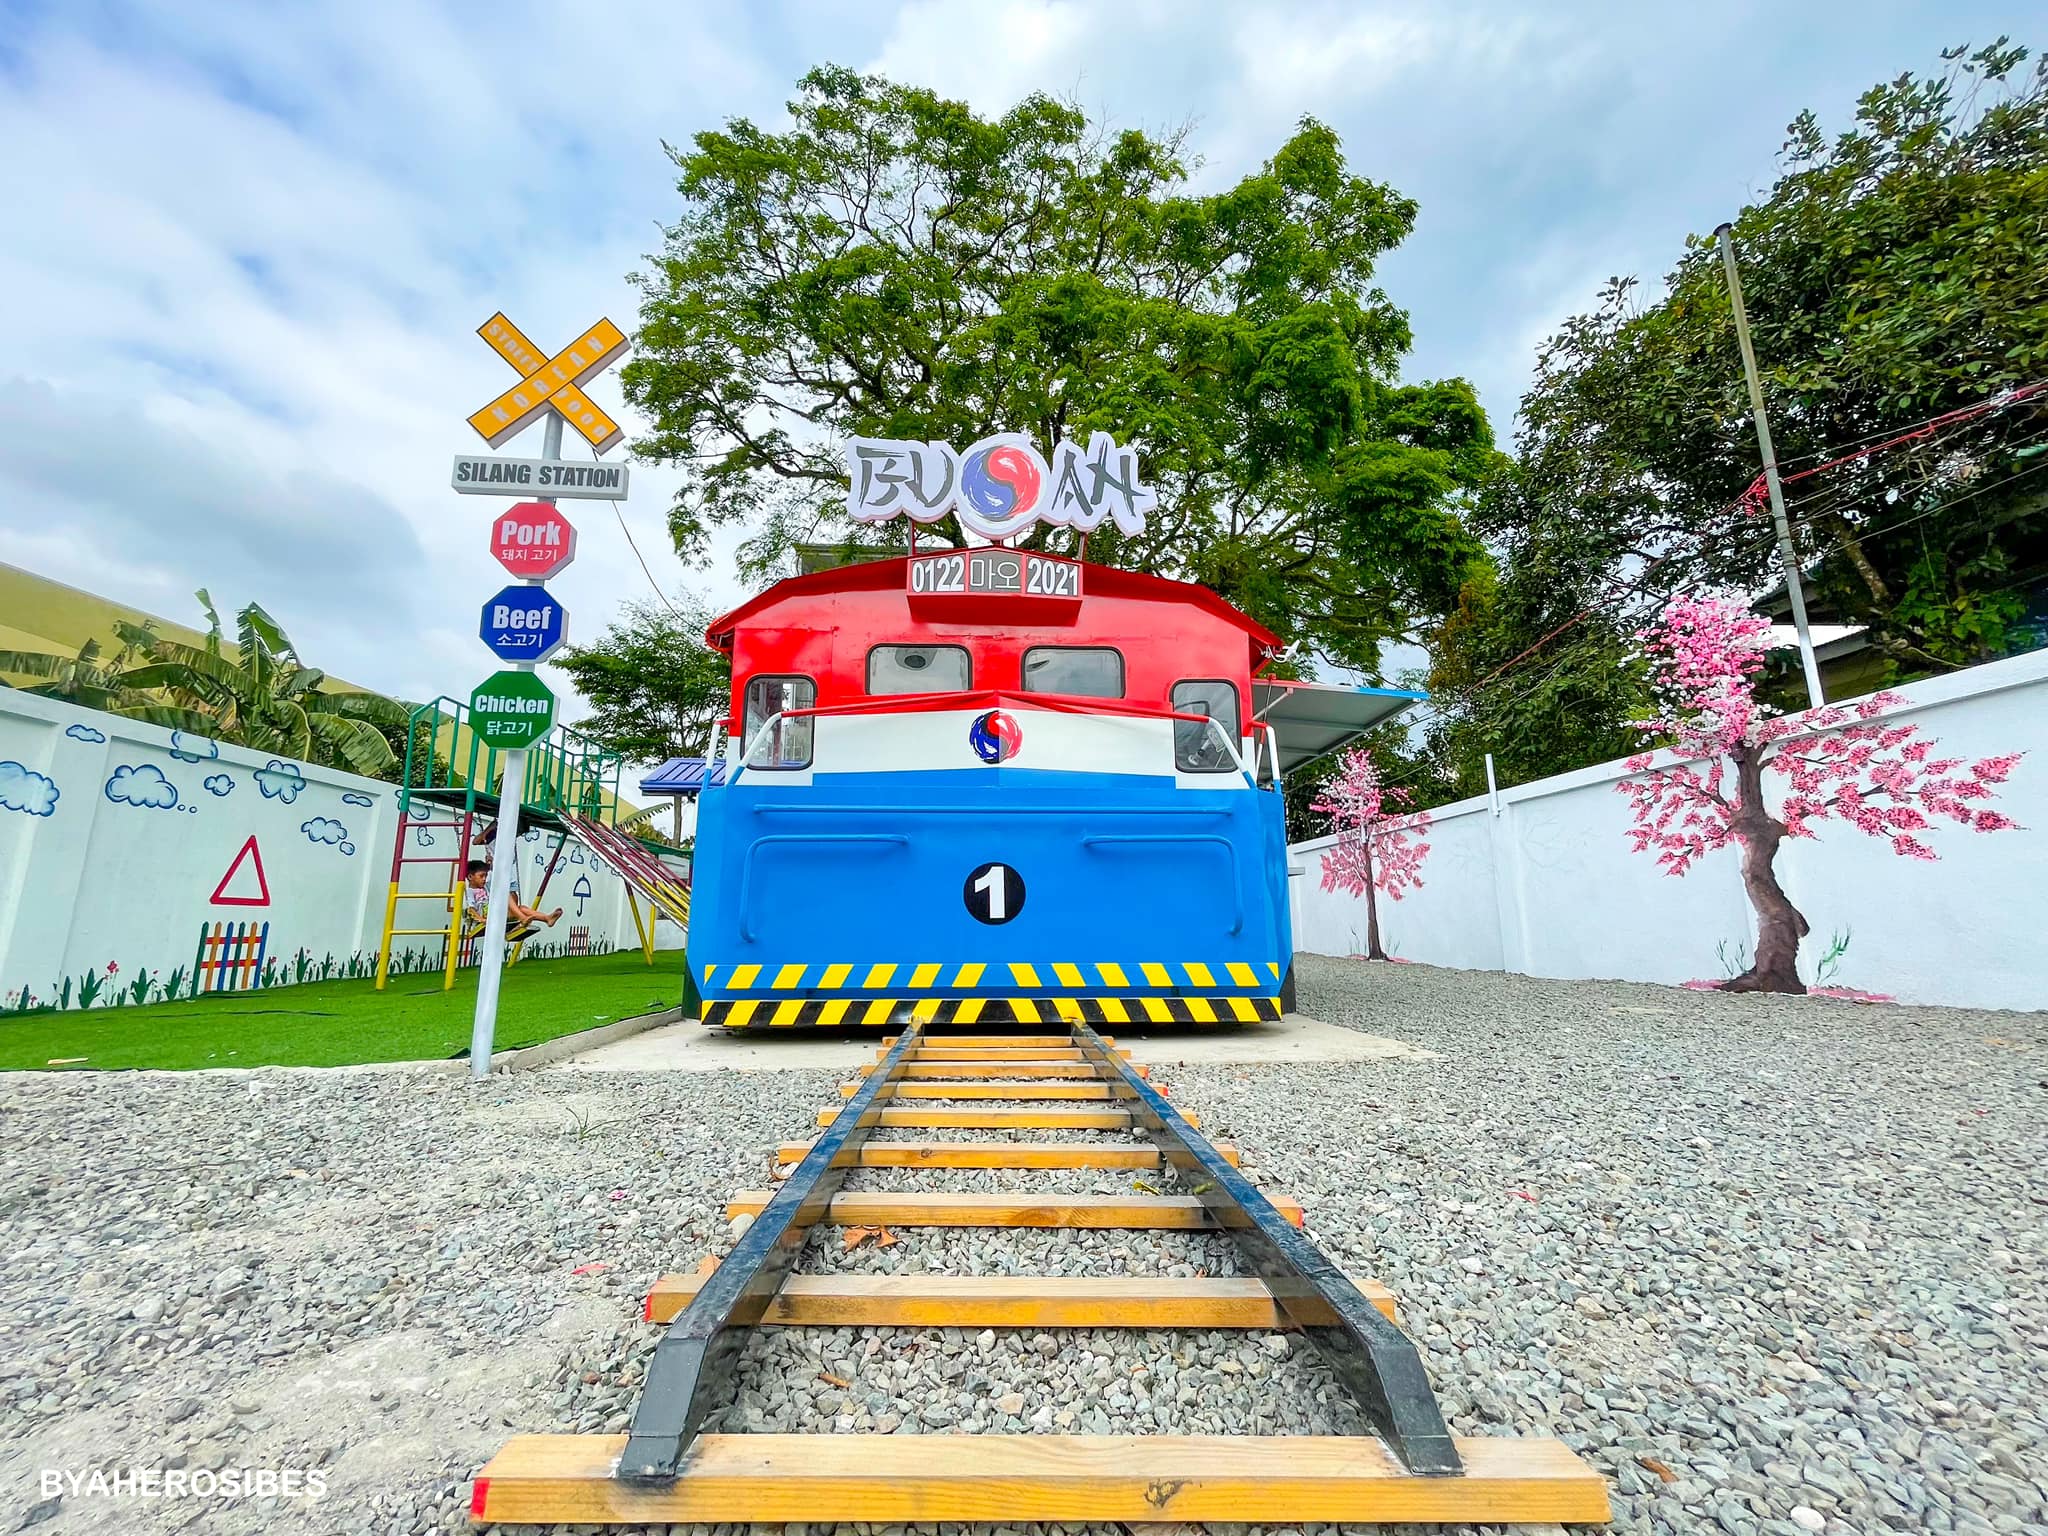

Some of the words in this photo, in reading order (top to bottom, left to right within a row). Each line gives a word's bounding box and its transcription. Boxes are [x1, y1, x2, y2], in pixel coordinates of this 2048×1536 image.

[487, 323, 539, 372] STREET
[491, 336, 605, 423] KOREAN
[456, 461, 531, 484] SILANG
[538, 466, 620, 488] STATION
[501, 520, 561, 546] Pork
[501, 548, 528, 561] 돼지
[530, 549, 557, 562] 고기
[912, 555, 965, 593] 0122
[970, 558, 1021, 590] 마오
[1026, 557, 1078, 596] 2021
[492, 604, 552, 630] Beef
[496, 633, 543, 648] 소고기
[474, 694, 549, 714] Chicken
[486, 720, 533, 737] 닭고기
[974, 865, 1006, 919] 1
